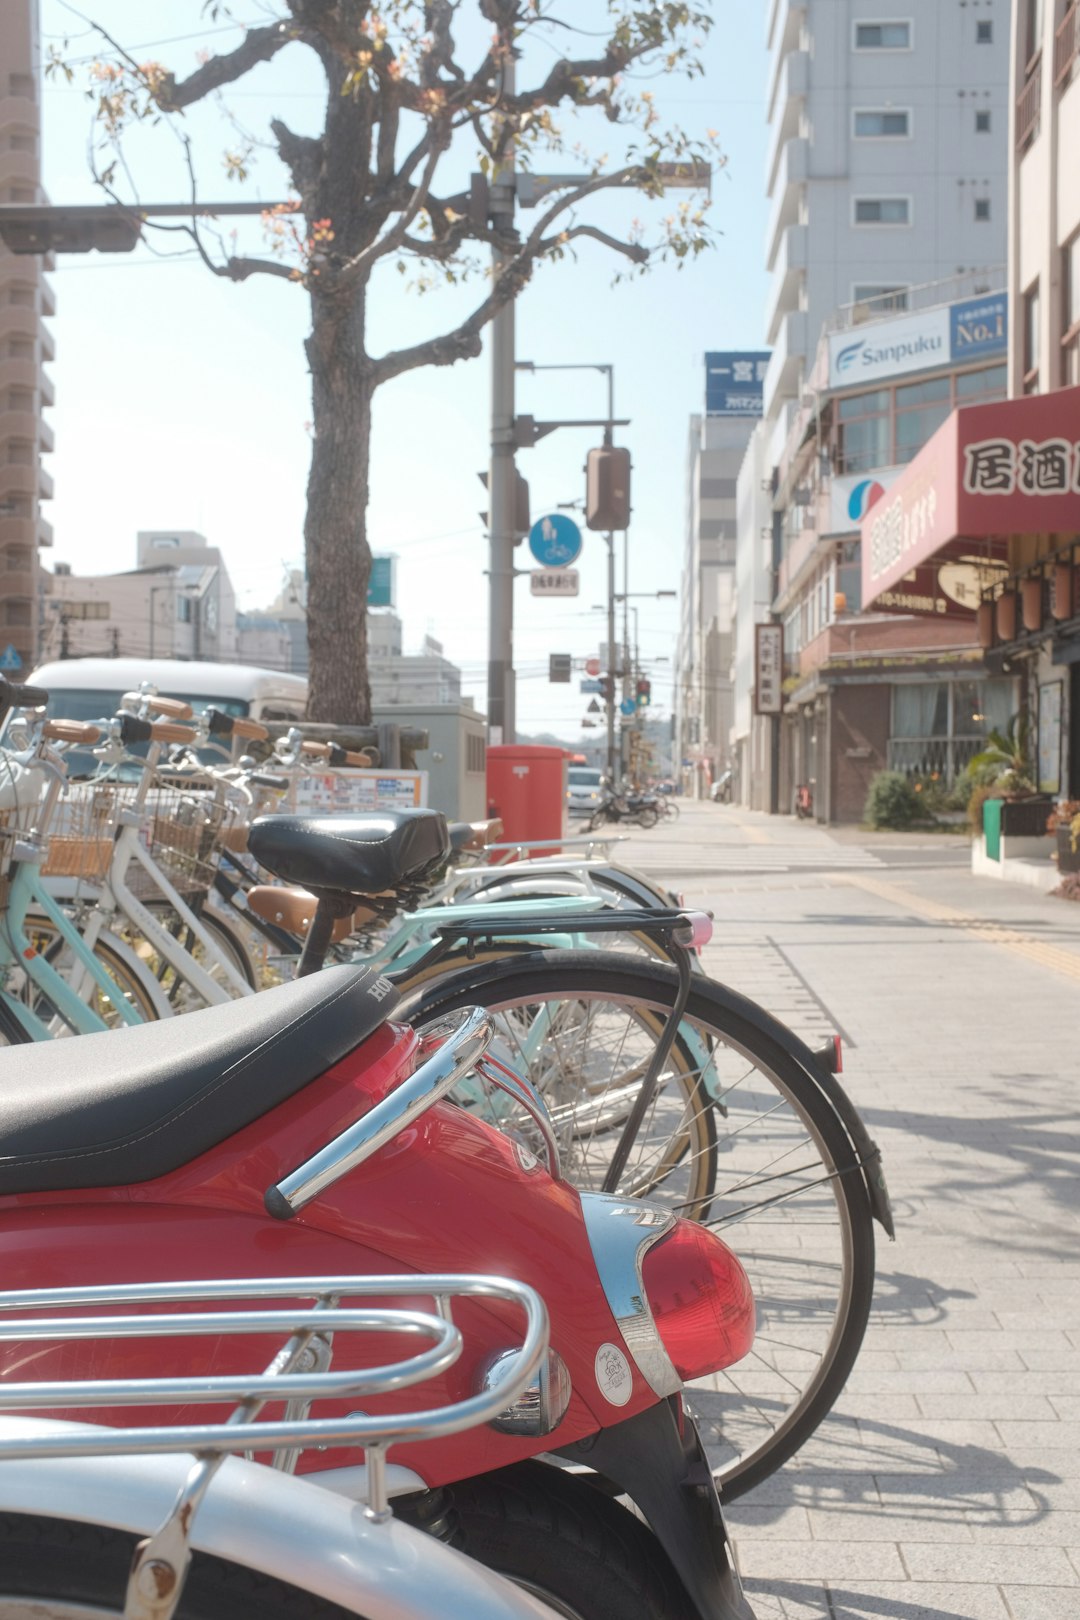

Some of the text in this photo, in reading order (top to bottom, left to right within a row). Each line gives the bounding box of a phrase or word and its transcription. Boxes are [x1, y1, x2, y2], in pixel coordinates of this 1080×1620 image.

[956, 314, 1004, 347] No.1
[861, 334, 942, 366] Sanpuku
[963, 437, 1080, 496] 居酒
